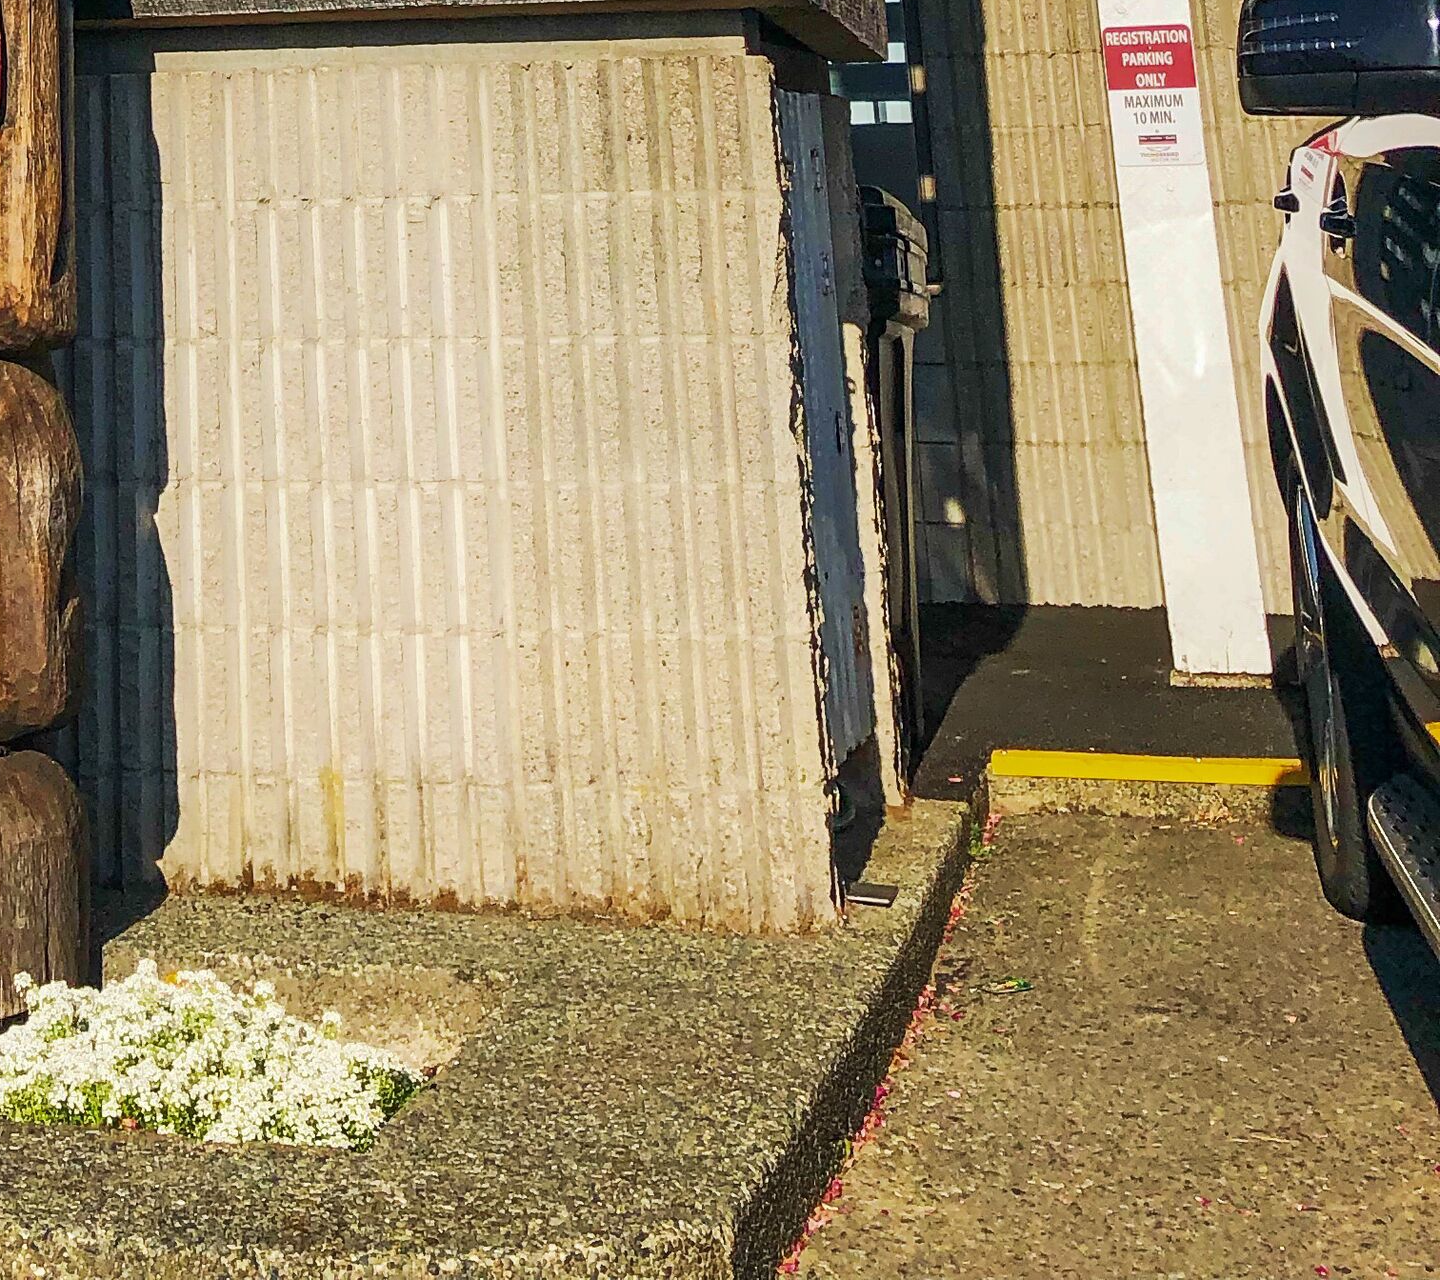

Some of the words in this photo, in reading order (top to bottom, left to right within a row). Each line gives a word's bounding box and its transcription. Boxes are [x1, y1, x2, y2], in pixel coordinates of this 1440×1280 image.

[1105, 30, 1188, 46] REGISTRATION
[1122, 51, 1173, 66] PARKING
[1135, 73, 1166, 88] ONLY
[1124, 94, 1183, 109] MAXIMUM
[1133, 112, 1147, 125] 10
[1149, 111, 1176, 124] MIN.
